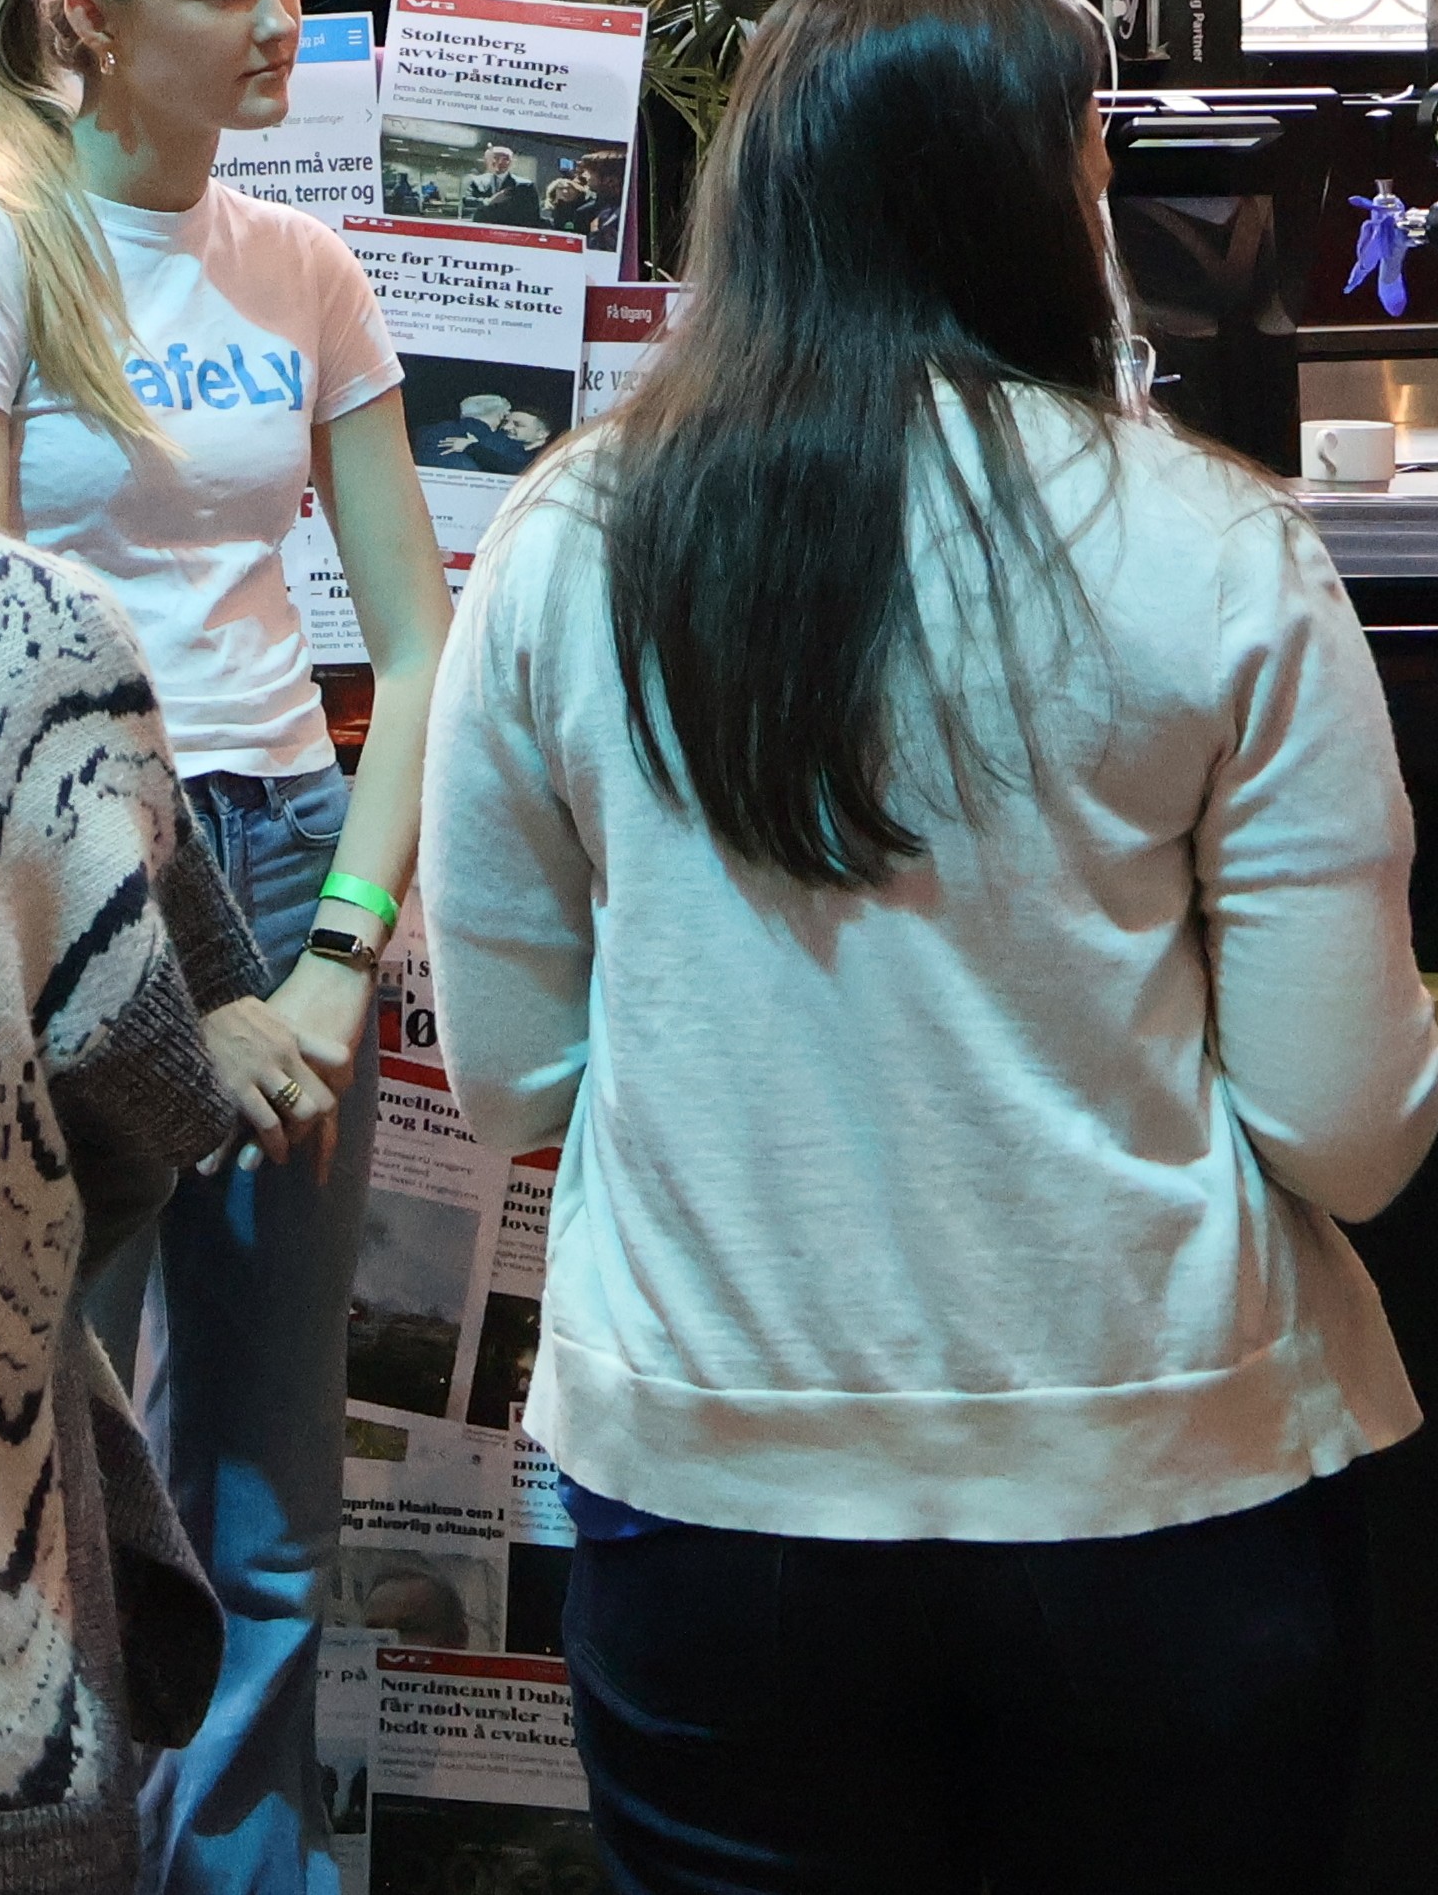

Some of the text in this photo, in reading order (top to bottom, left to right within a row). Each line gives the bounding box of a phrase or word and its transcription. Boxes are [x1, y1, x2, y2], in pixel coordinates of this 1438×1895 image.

[401, 27, 526, 54] Stoltenberg
[1192, 12, 1206, 64] Partner
[399, 46, 569, 75] avviser Trumps
[397, 60, 568, 93] Nato-påstander
[295, 151, 324, 174] må
[327, 155, 374, 172] være
[295, 186, 347, 203] terror
[351, 184, 374, 205] og
[438, 254, 521, 277] Trump-
[421, 270, 511, 293] Ukraina
[515, 279, 554, 296] har
[392, 287, 501, 310] europeisk
[504, 299, 564, 315] støtte
[388, 1113, 417, 1132] og
[381, 1676, 501, 1700] Nordmenn
[433, 1725, 468, 1739] om
